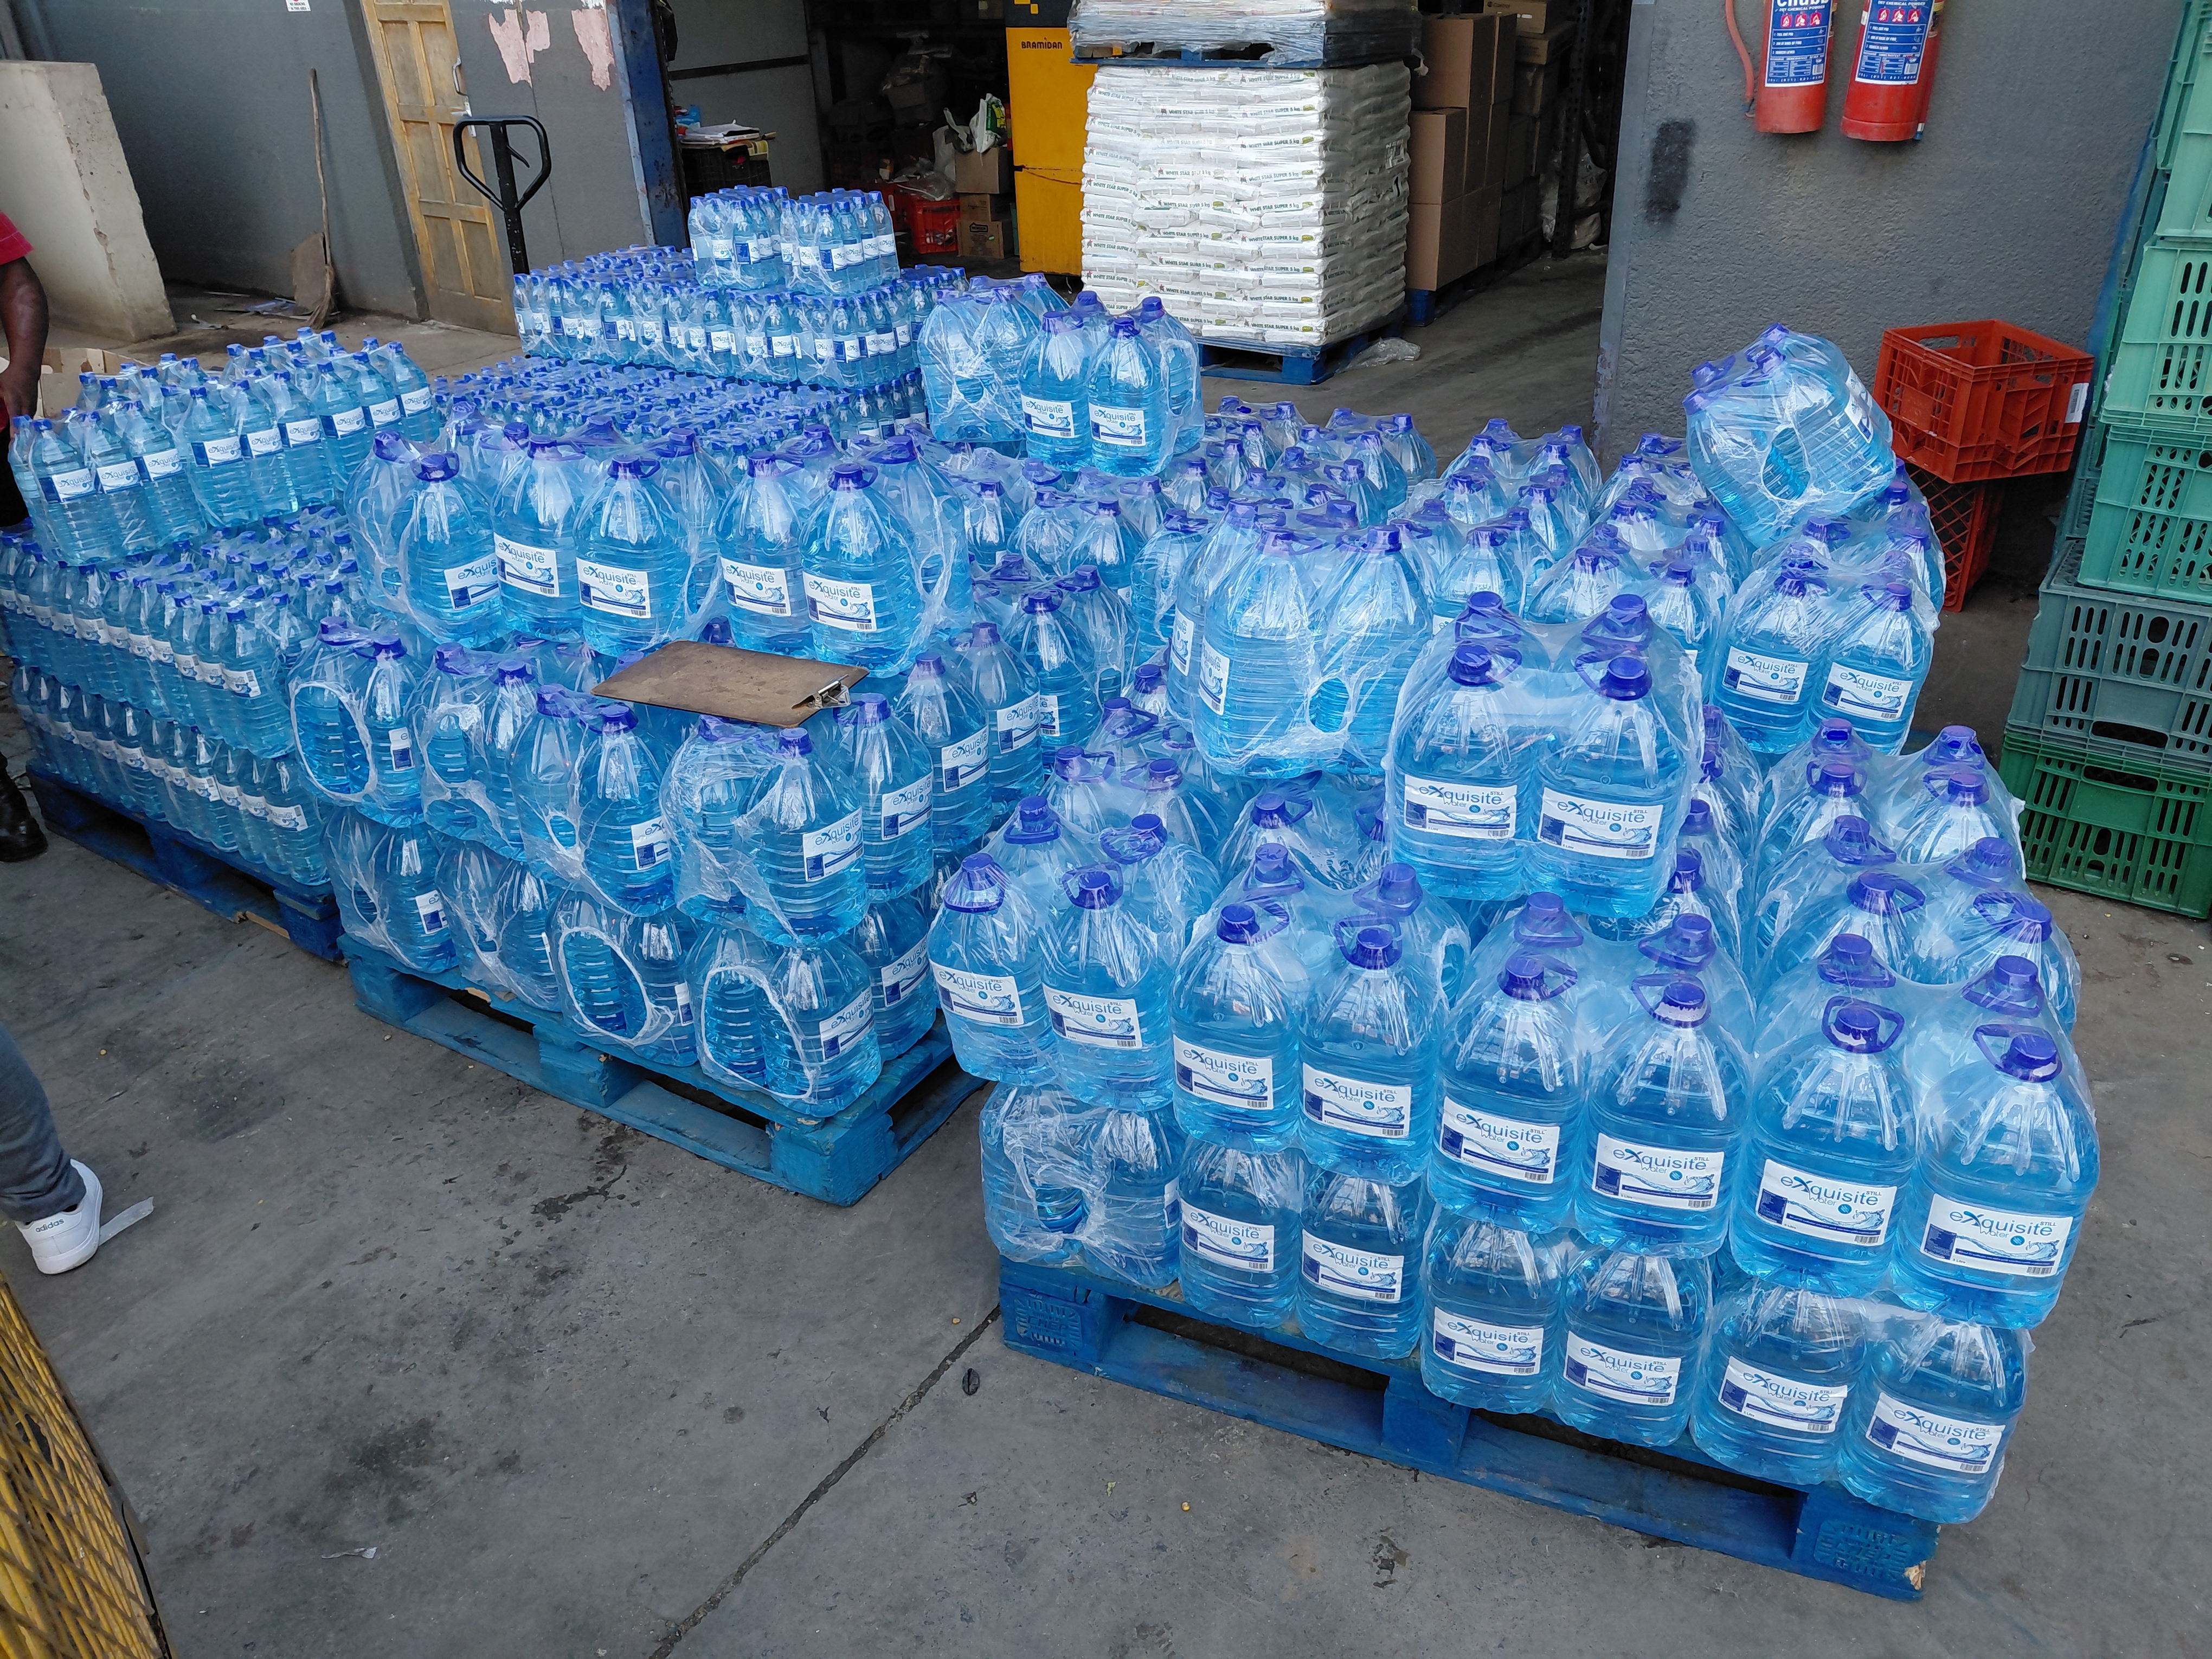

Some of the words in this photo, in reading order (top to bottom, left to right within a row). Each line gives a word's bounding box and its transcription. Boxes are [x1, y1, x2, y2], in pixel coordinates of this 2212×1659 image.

[1026, 401, 1064, 413] eXquisite
[1095, 409, 1136, 421] eXquisite
[499, 542, 545, 563] eXquisite
[458, 559, 496, 580] eXquis
[583, 566, 636, 584] eXquisite
[726, 565, 775, 583] eXquisite
[808, 580, 860, 599] eXquisite
[1738, 655, 1796, 674] eXquisite
[1840, 671, 1900, 692] eXquisite
[1007, 698, 1039, 721] eXquisite
[952, 733, 987, 758] eXquisite
[893, 780, 931, 806] eXquisite
[1419, 785, 1502, 805] eXquisite
[1443, 797, 1467, 807] water
[1558, 801, 1645, 823] eXquisite
[1583, 815, 1607, 826] water
[815, 818, 860, 846] eXquisite
[939, 970, 1002, 992] eXquisite
[1053, 994, 1121, 1014] eXquisite
[1183, 1049, 1257, 1075] eXquisite
[1205, 1064, 1226, 1076] water
[1315, 1077, 1395, 1103] eXquisite
[1339, 1094, 1360, 1103] water
[1456, 1113, 1543, 1143] eXquisite
[1481, 1131, 1505, 1144] water
[1613, 1148, 1707, 1171] eXquisite
[1641, 1165, 1667, 1174] water
[1780, 1175, 1878, 1206] eXquisite
[1809, 1195, 1836, 1207] water
[36, 1219, 64, 1232] adidas
[1190, 1212, 1259, 1239] eXquisite
[1210, 1228, 1230, 1238] water
[1950, 1211, 2053, 1237] eXquisite
[1979, 1228, 2009, 1238] water
[1313, 1243, 1388, 1269] eXquisite
[1334, 1259, 1356, 1270] water
[1447, 1321, 1528, 1343] eXquisite
[1472, 1336, 1494, 1345] water
[1580, 1346, 1664, 1373] eXquisite
[1605, 1363, 1630, 1373] water
[1742, 1371, 1830, 1402] eXquisite
[1767, 1389, 1792, 1401] water
[1893, 1409, 1986, 1440] eXquisite
[1919, 1426, 1946, 1439] water
